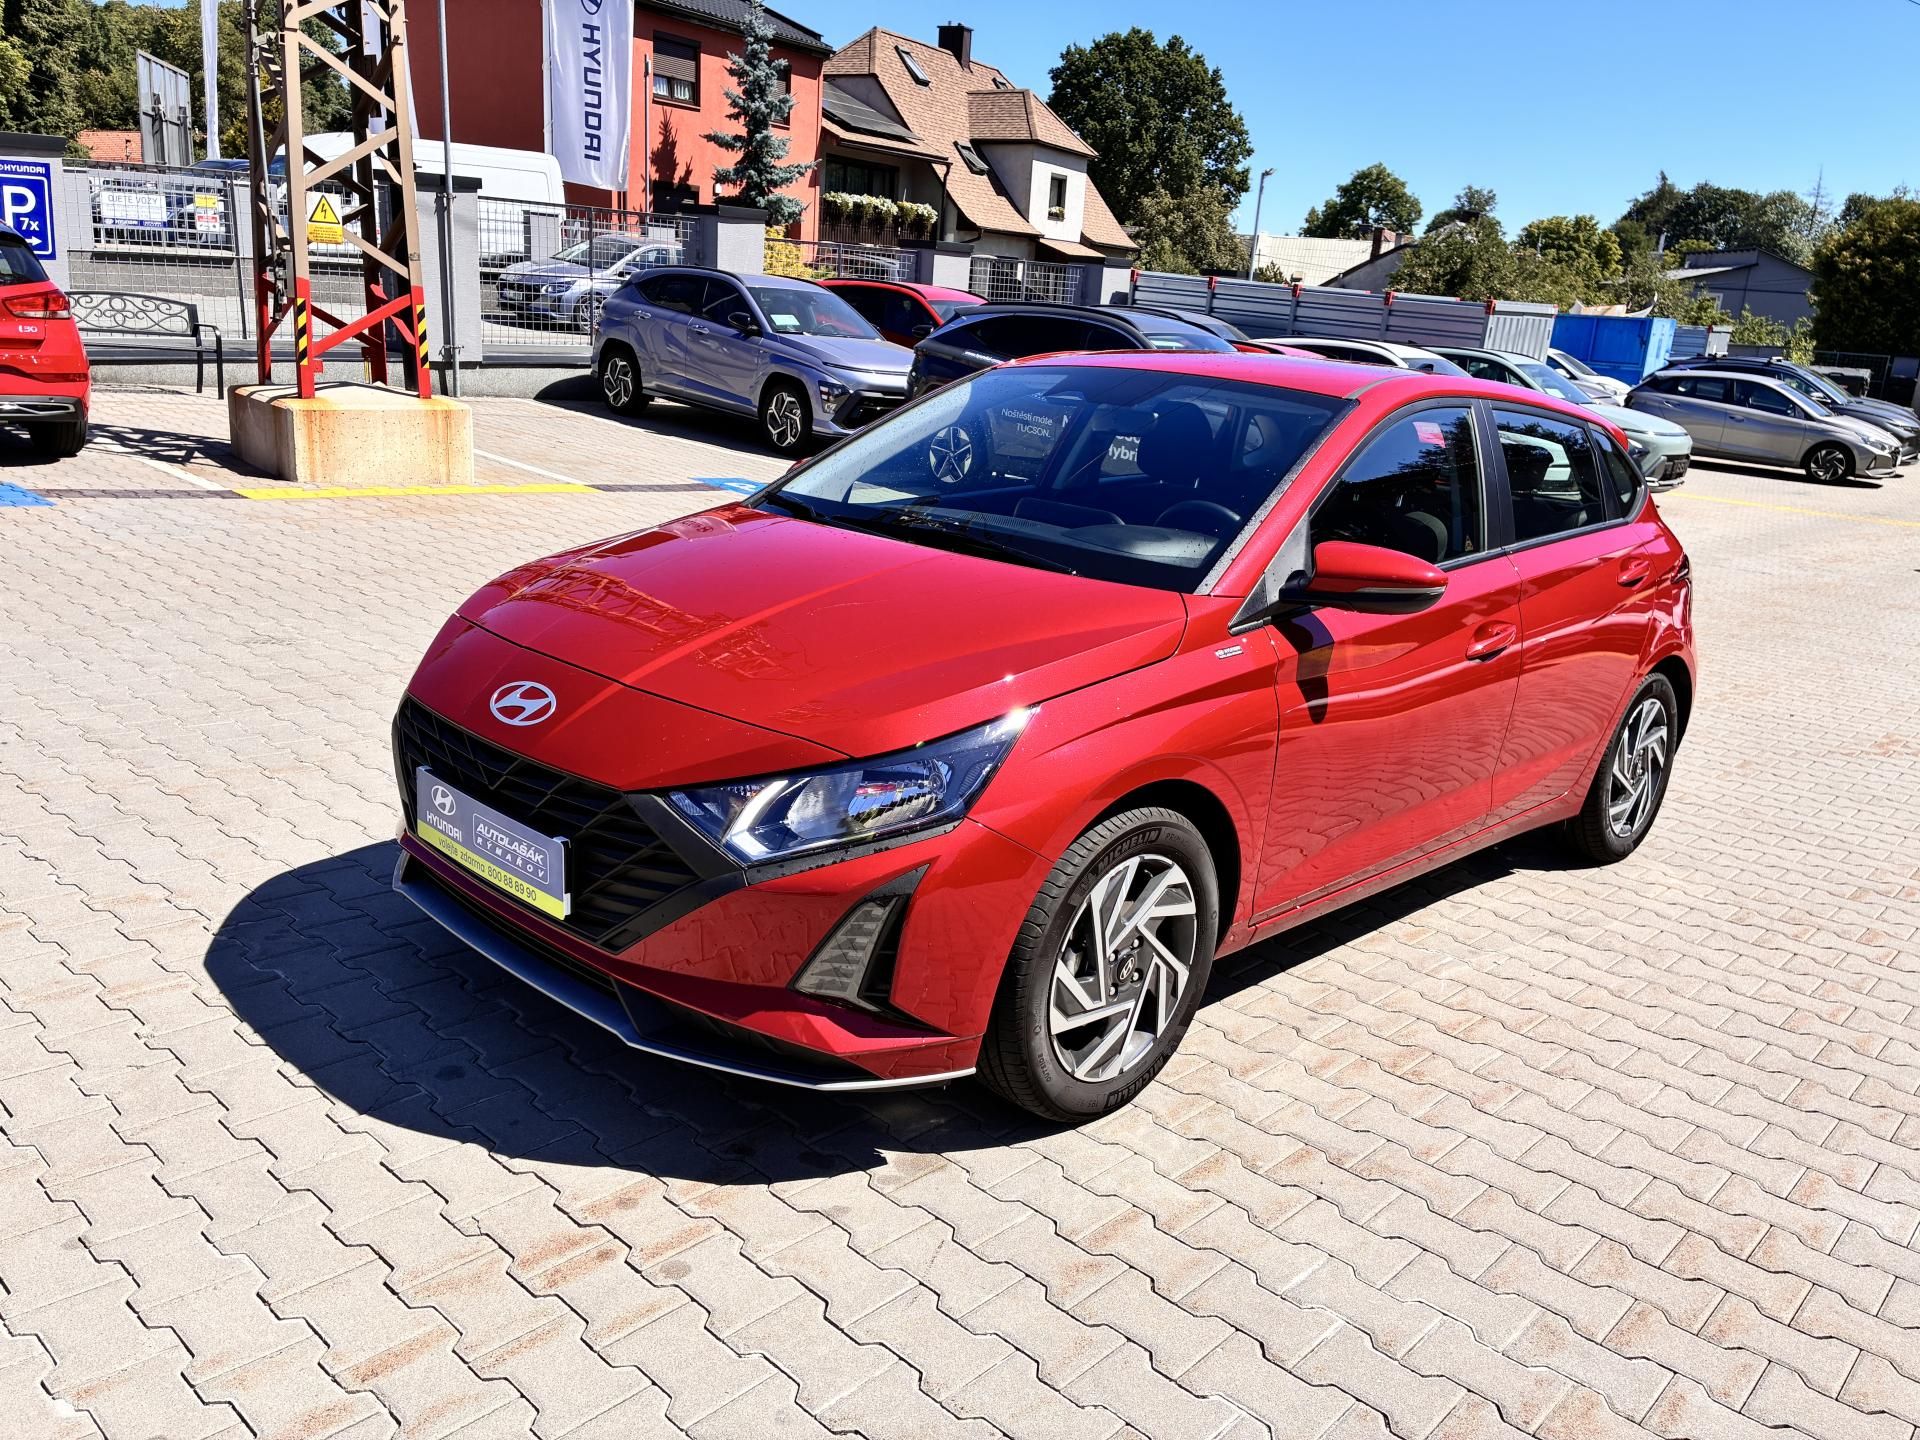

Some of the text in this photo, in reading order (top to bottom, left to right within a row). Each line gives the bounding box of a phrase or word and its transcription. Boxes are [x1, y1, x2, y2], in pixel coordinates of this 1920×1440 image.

[582, 23, 602, 162] HYUNDAI
[4, 163, 46, 174] HYUNDAI
[2, 185, 36, 229] P
[20, 217, 40, 231] 7x
[1032, 415, 1053, 426] máte
[426, 811, 462, 842] HYUNDAI
[476, 823, 544, 866] AUTOLAŠÁK
[438, 837, 458, 857] volejte
[460, 851, 485, 872] zdarma
[487, 867, 503, 883] 800
[514, 881, 525, 895] 89
[526, 887, 537, 902] 90
[1097, 828, 1161, 871] MICHELIN
